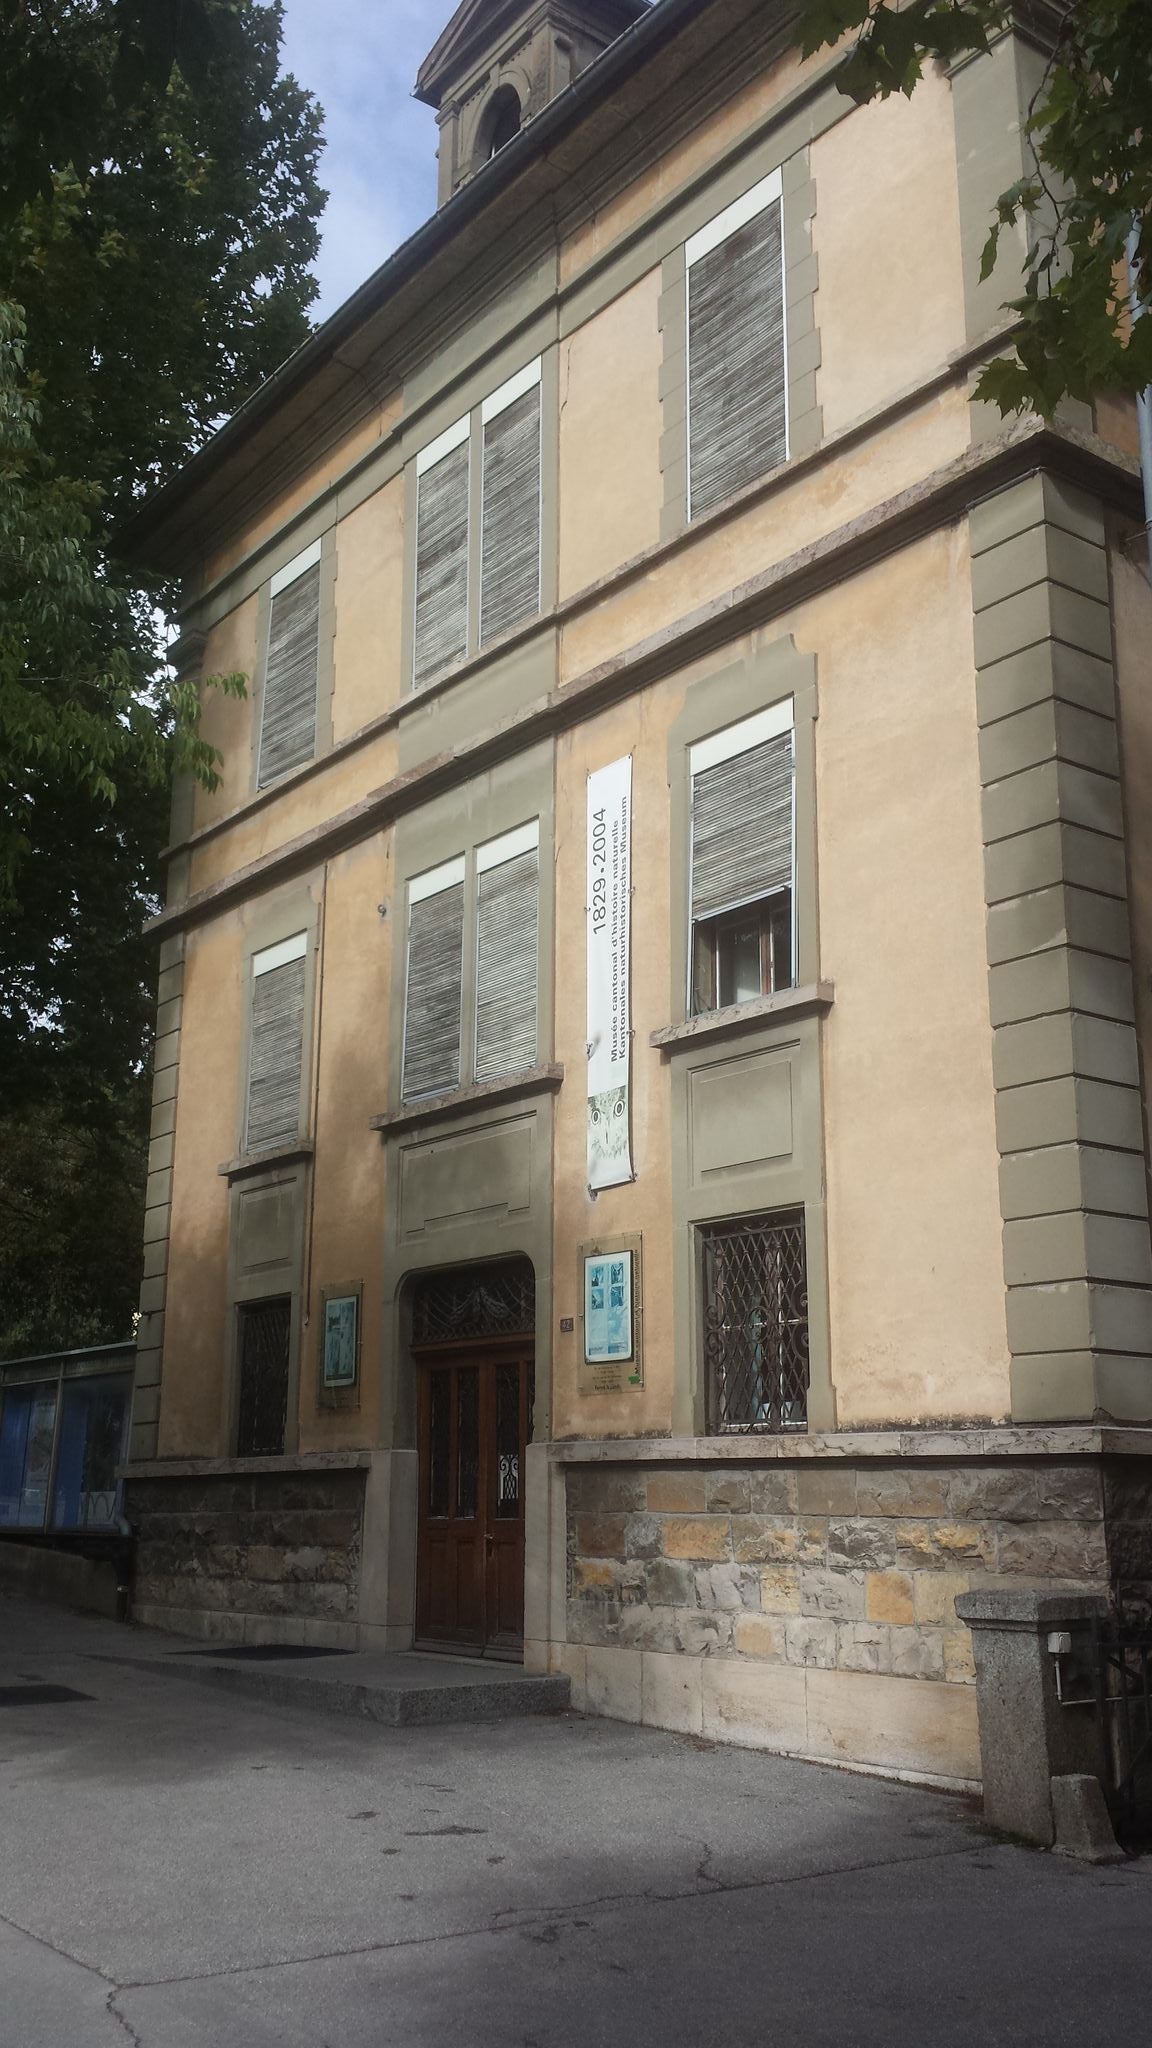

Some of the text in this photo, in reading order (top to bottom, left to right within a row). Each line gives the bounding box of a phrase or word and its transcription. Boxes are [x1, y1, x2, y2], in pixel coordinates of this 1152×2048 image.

[611, 820, 619, 880] naturelle
[619, 857, 627, 976] naturhistorisches
[610, 1016, 618, 1063] Musée
